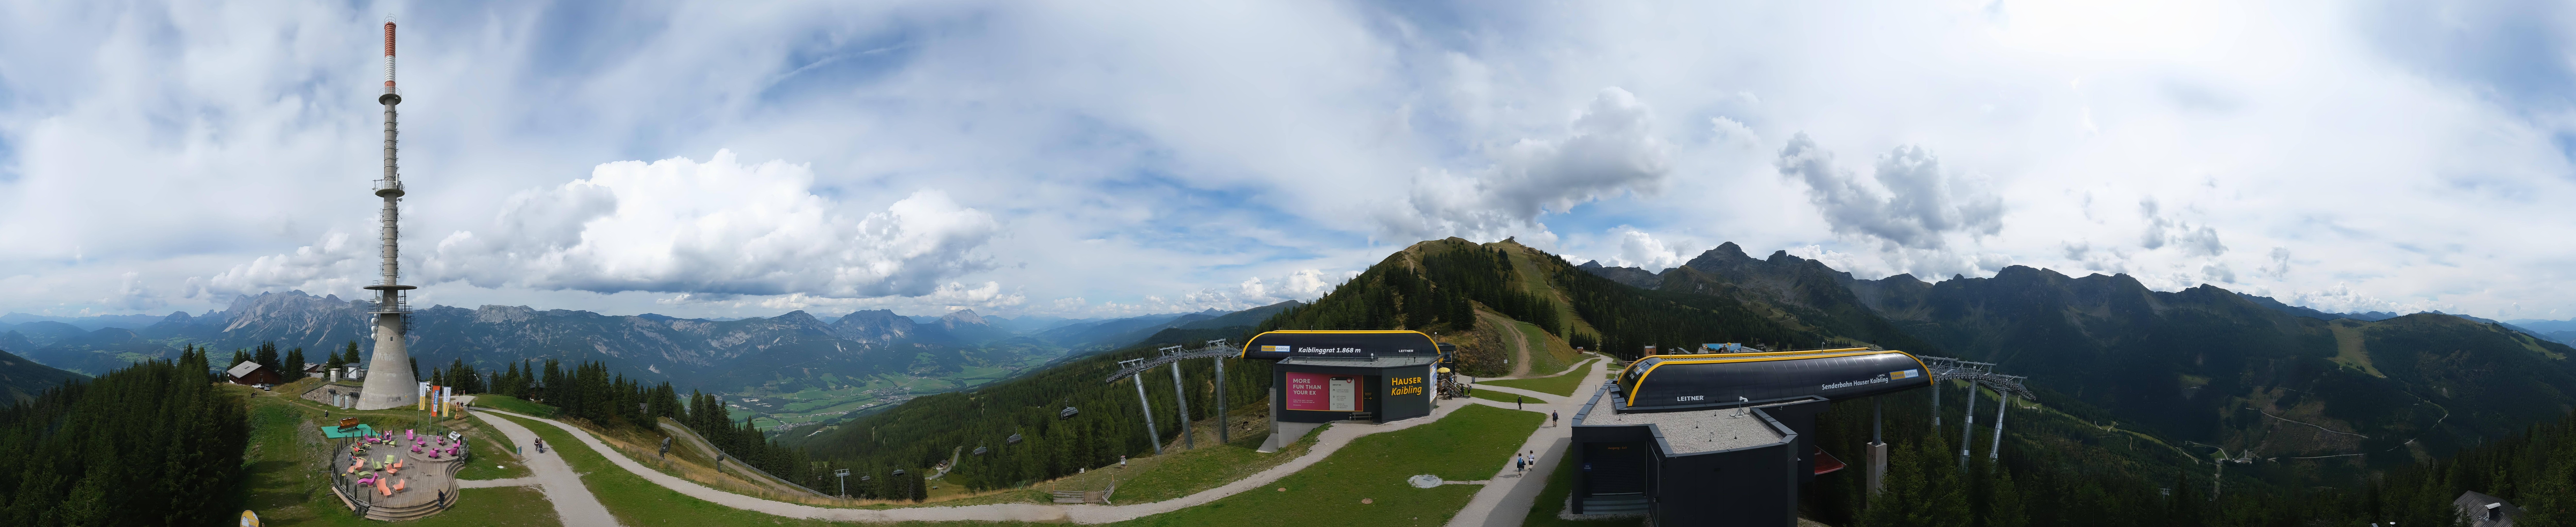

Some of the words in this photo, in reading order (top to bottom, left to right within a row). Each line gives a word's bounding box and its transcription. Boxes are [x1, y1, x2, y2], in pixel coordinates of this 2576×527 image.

[1392, 377, 1421, 386] HAUSER
[1822, 381, 1852, 390] Senderbahn
[1391, 386, 1422, 396] Kaibling
